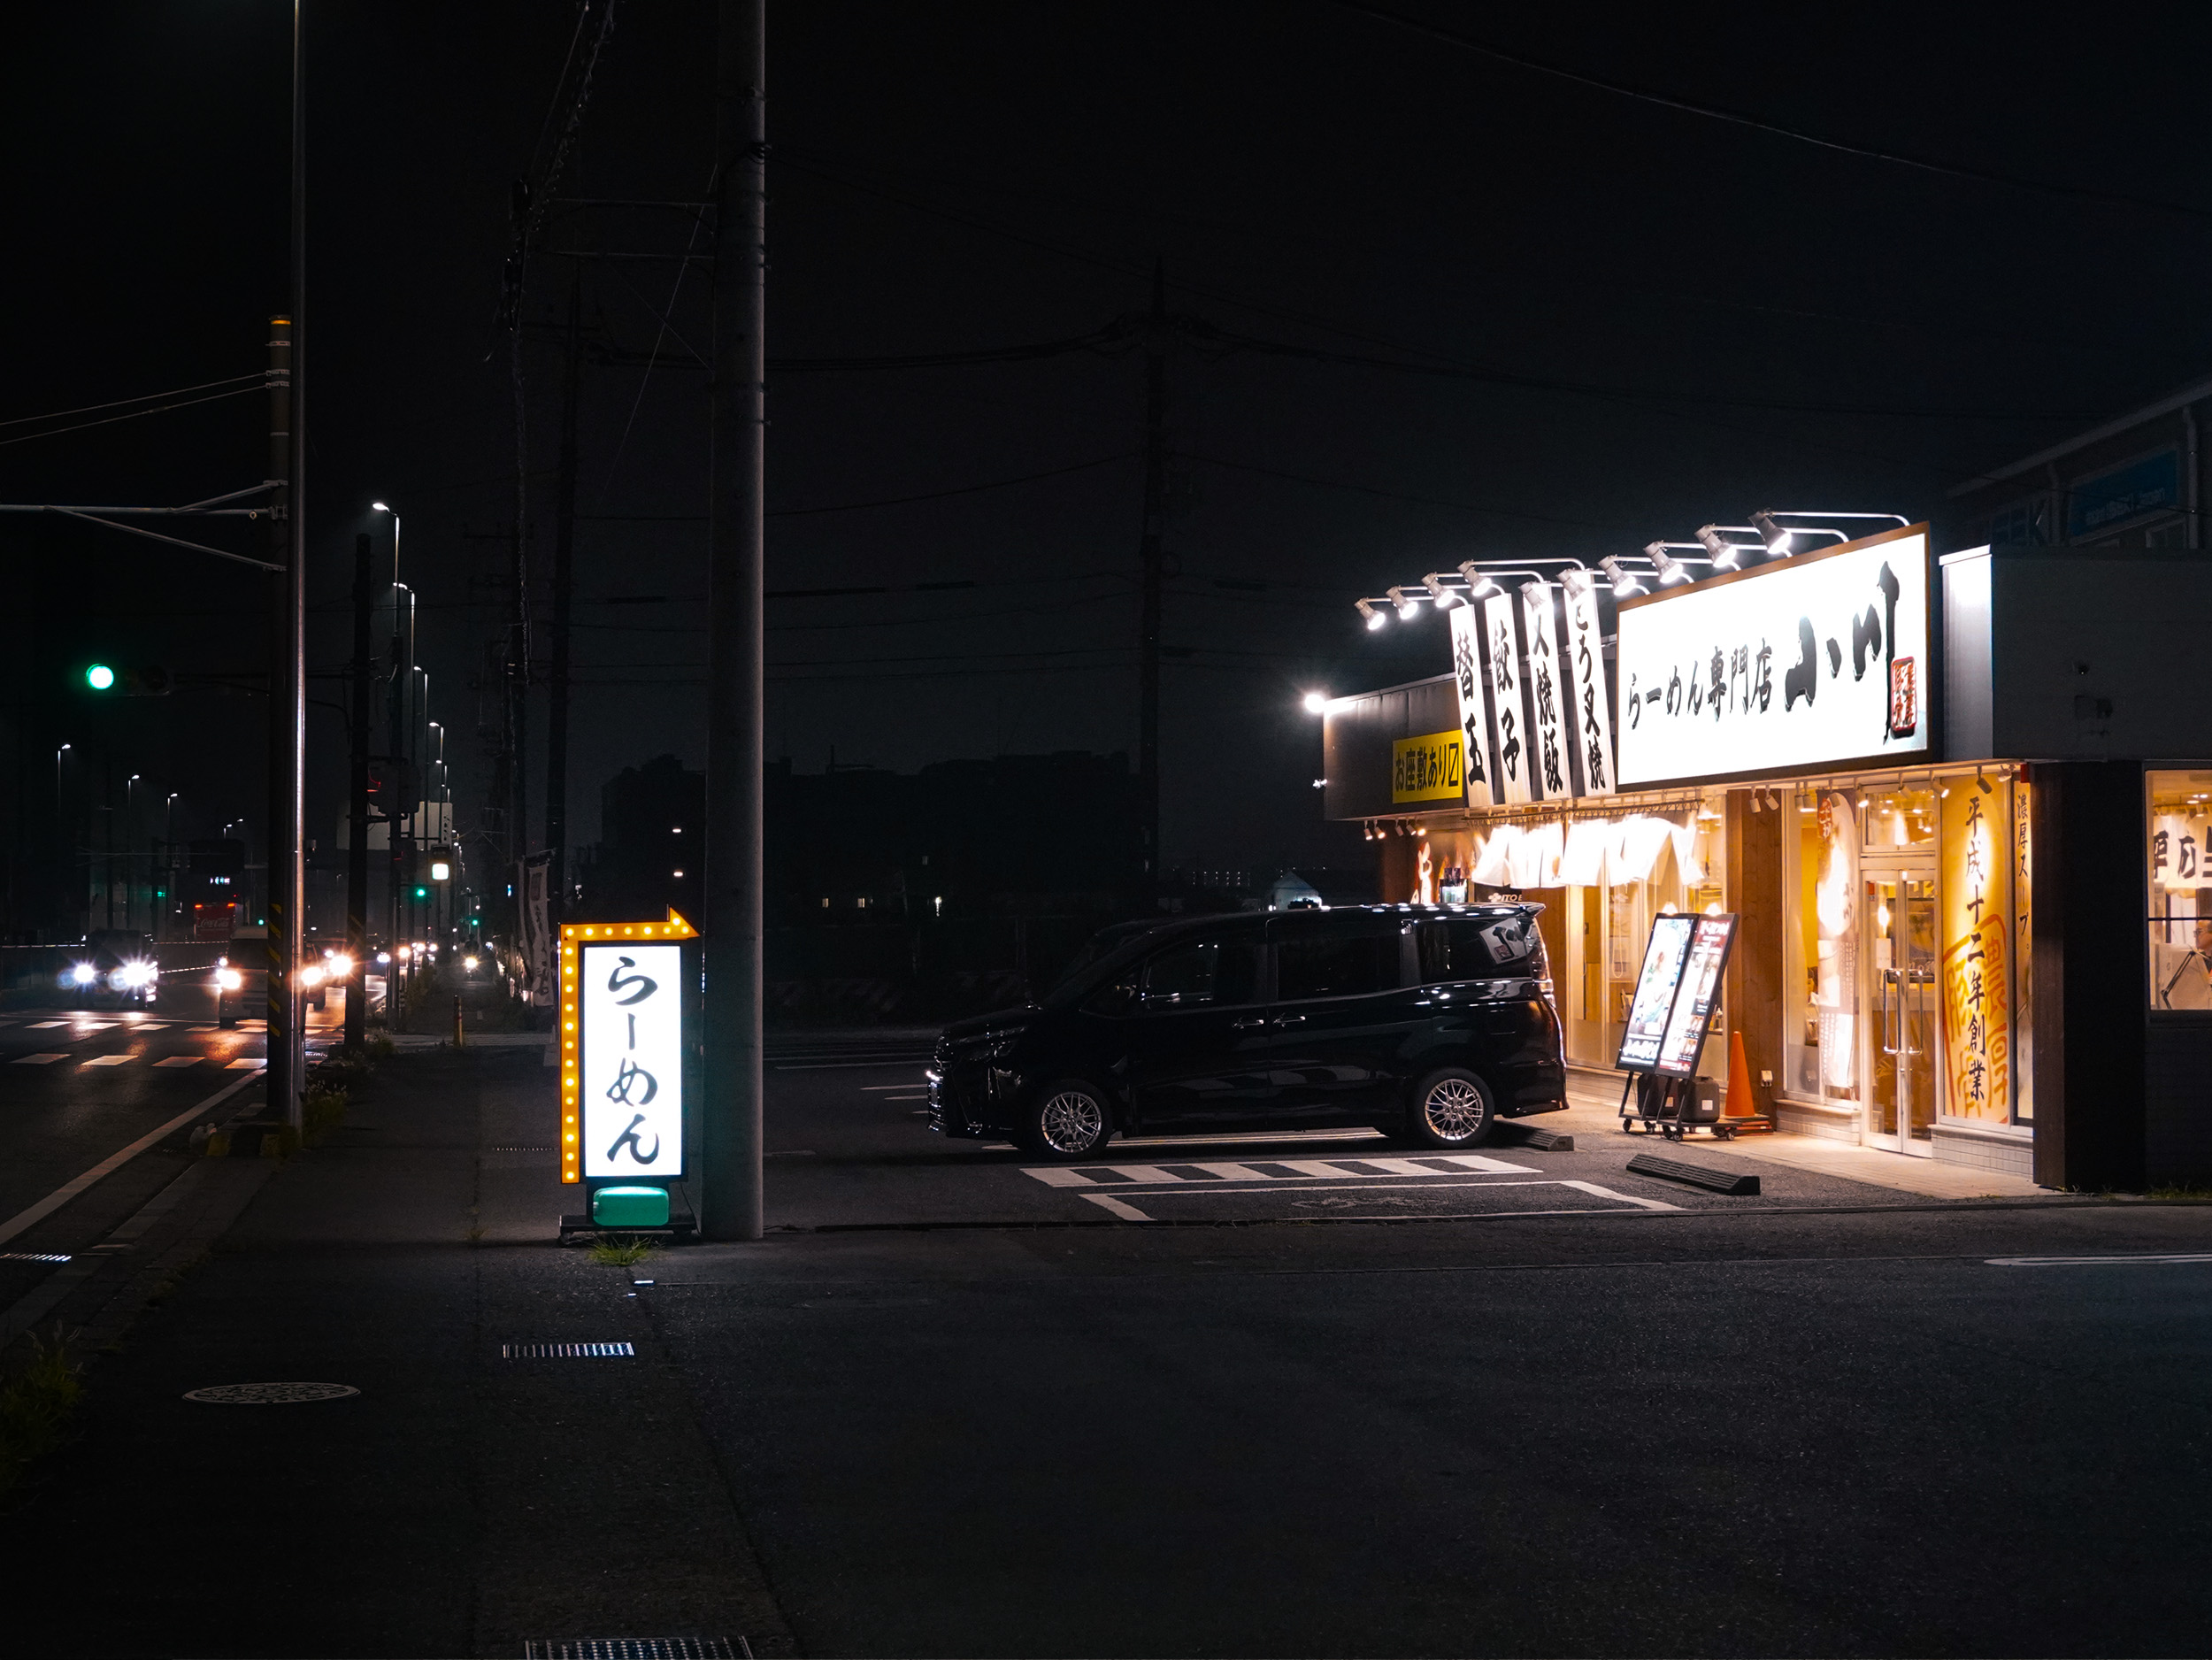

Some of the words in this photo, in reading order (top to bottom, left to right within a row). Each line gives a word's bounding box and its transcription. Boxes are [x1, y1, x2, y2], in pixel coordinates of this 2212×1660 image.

[1455, 629, 1487, 787] 替玉
[1492, 619, 1521, 782] 餃子
[1627, 637, 1772, 730] らーめん専門店
[1785, 560, 1901, 745] 小川
[1965, 795, 1987, 1102] 平成十二年創業
[605, 956, 660, 1165] らーめん
